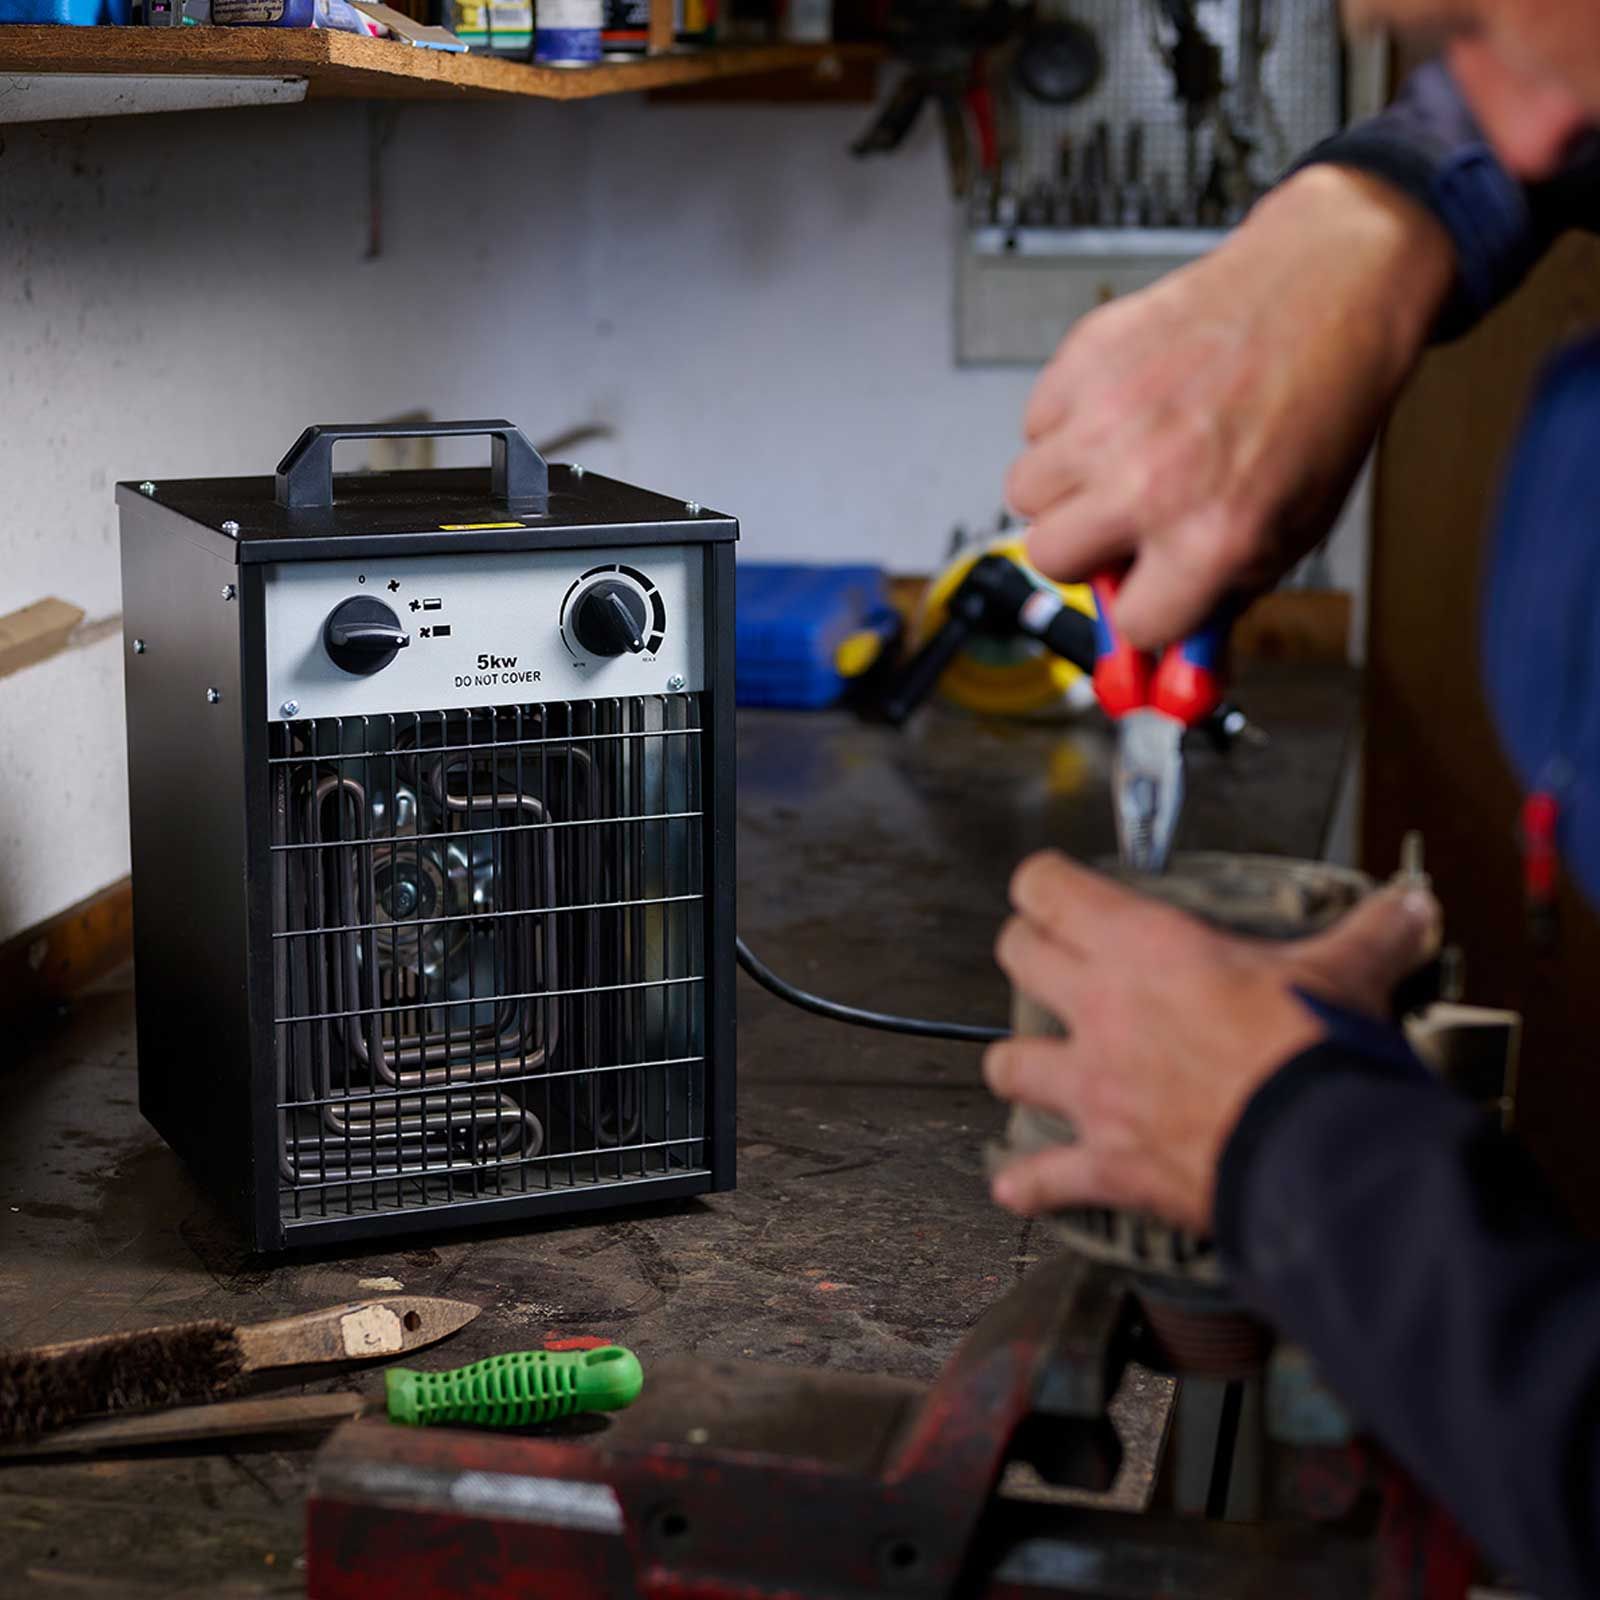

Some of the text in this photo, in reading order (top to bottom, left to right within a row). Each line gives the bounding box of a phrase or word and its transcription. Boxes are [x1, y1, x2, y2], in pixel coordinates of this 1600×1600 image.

[477, 654, 518, 670] 5kw
[455, 670, 541, 687] DO NOT COVER
